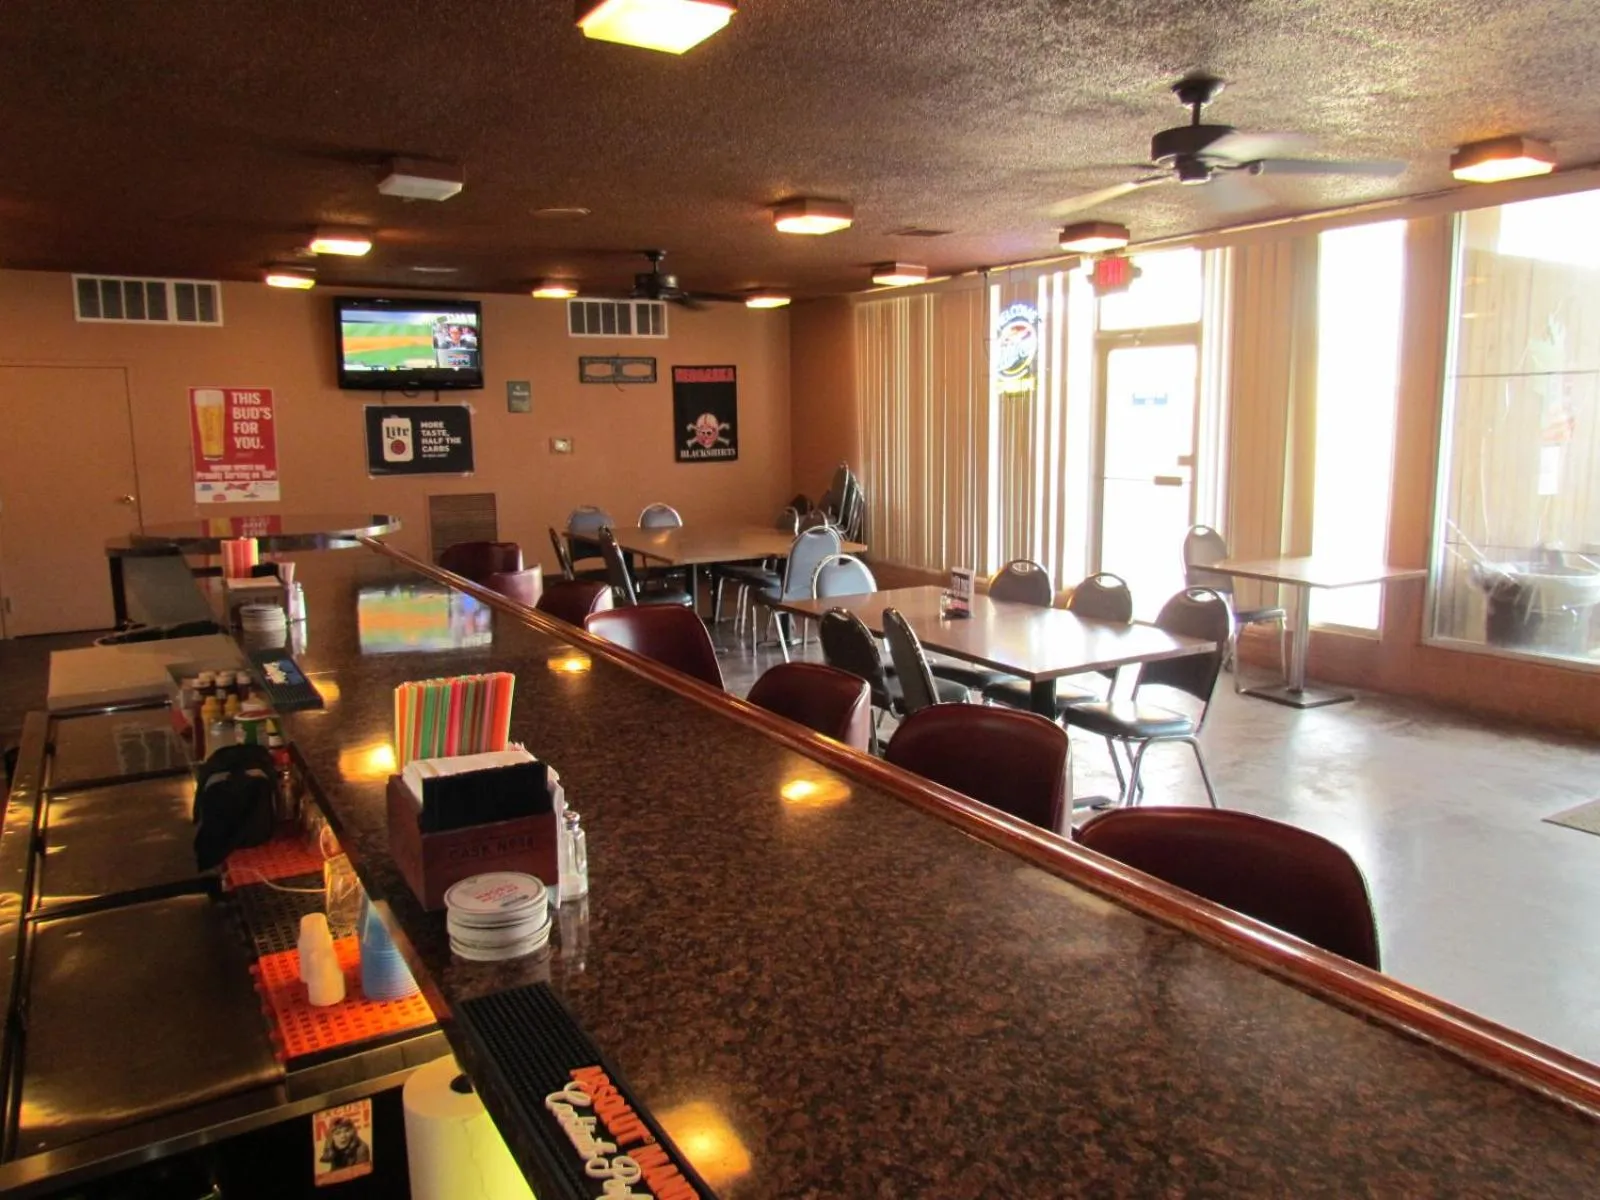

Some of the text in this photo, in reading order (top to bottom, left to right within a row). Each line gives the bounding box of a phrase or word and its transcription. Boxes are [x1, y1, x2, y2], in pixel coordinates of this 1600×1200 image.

[231, 392, 261, 405] THIS
[233, 406, 272, 420] BUD'S
[233, 421, 259, 435] FOR
[421, 421, 444, 429] MORE
[385, 426, 410, 440] Lite
[234, 436, 264, 450] YOU.
[422, 437, 444, 445] HALF
[681, 448, 736, 459] BLACKSHIRTS
